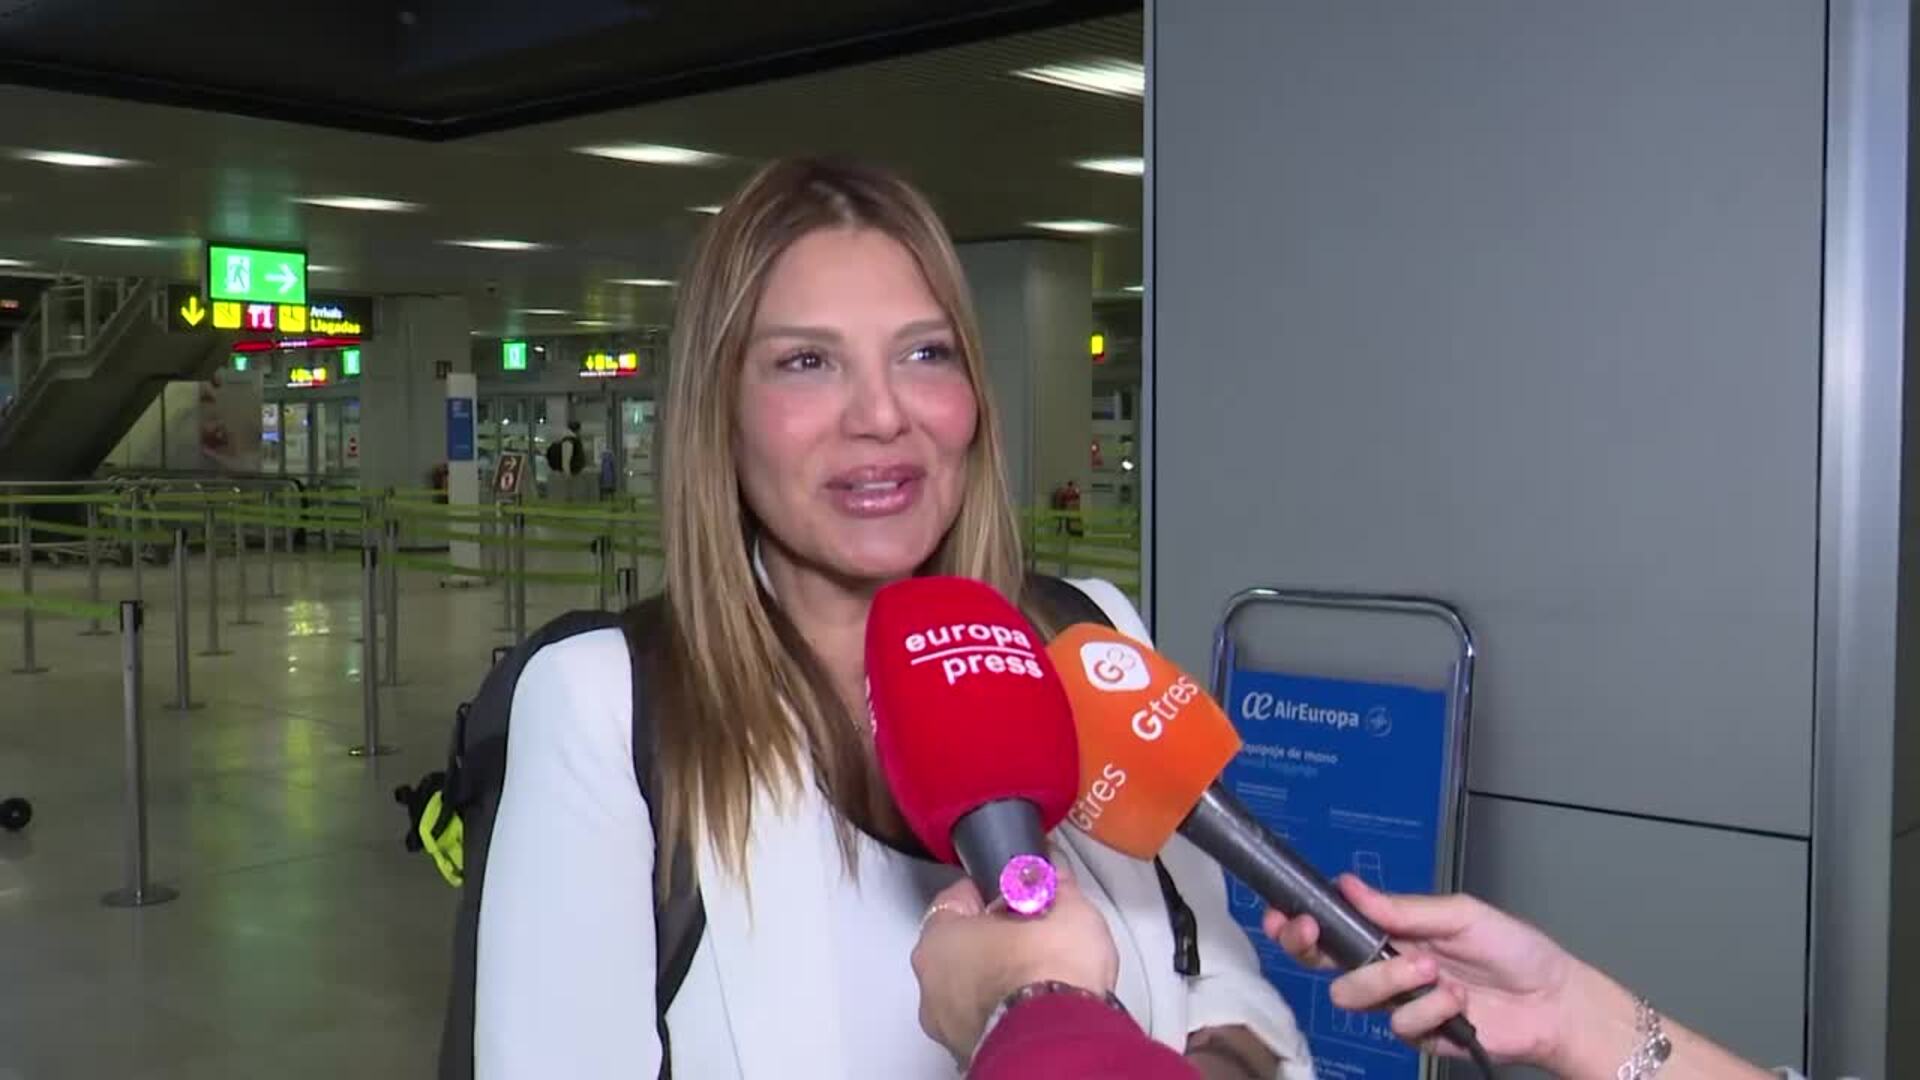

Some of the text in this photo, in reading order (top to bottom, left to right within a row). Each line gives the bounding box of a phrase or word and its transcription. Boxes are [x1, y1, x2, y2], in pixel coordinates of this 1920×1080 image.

[904, 623, 1032, 652] europa
[942, 655, 1044, 686] press
[1131, 674, 1199, 741] Gtres
[1274, 701, 1360, 729] AirEuropa
[1067, 762, 1127, 830] Gtres
